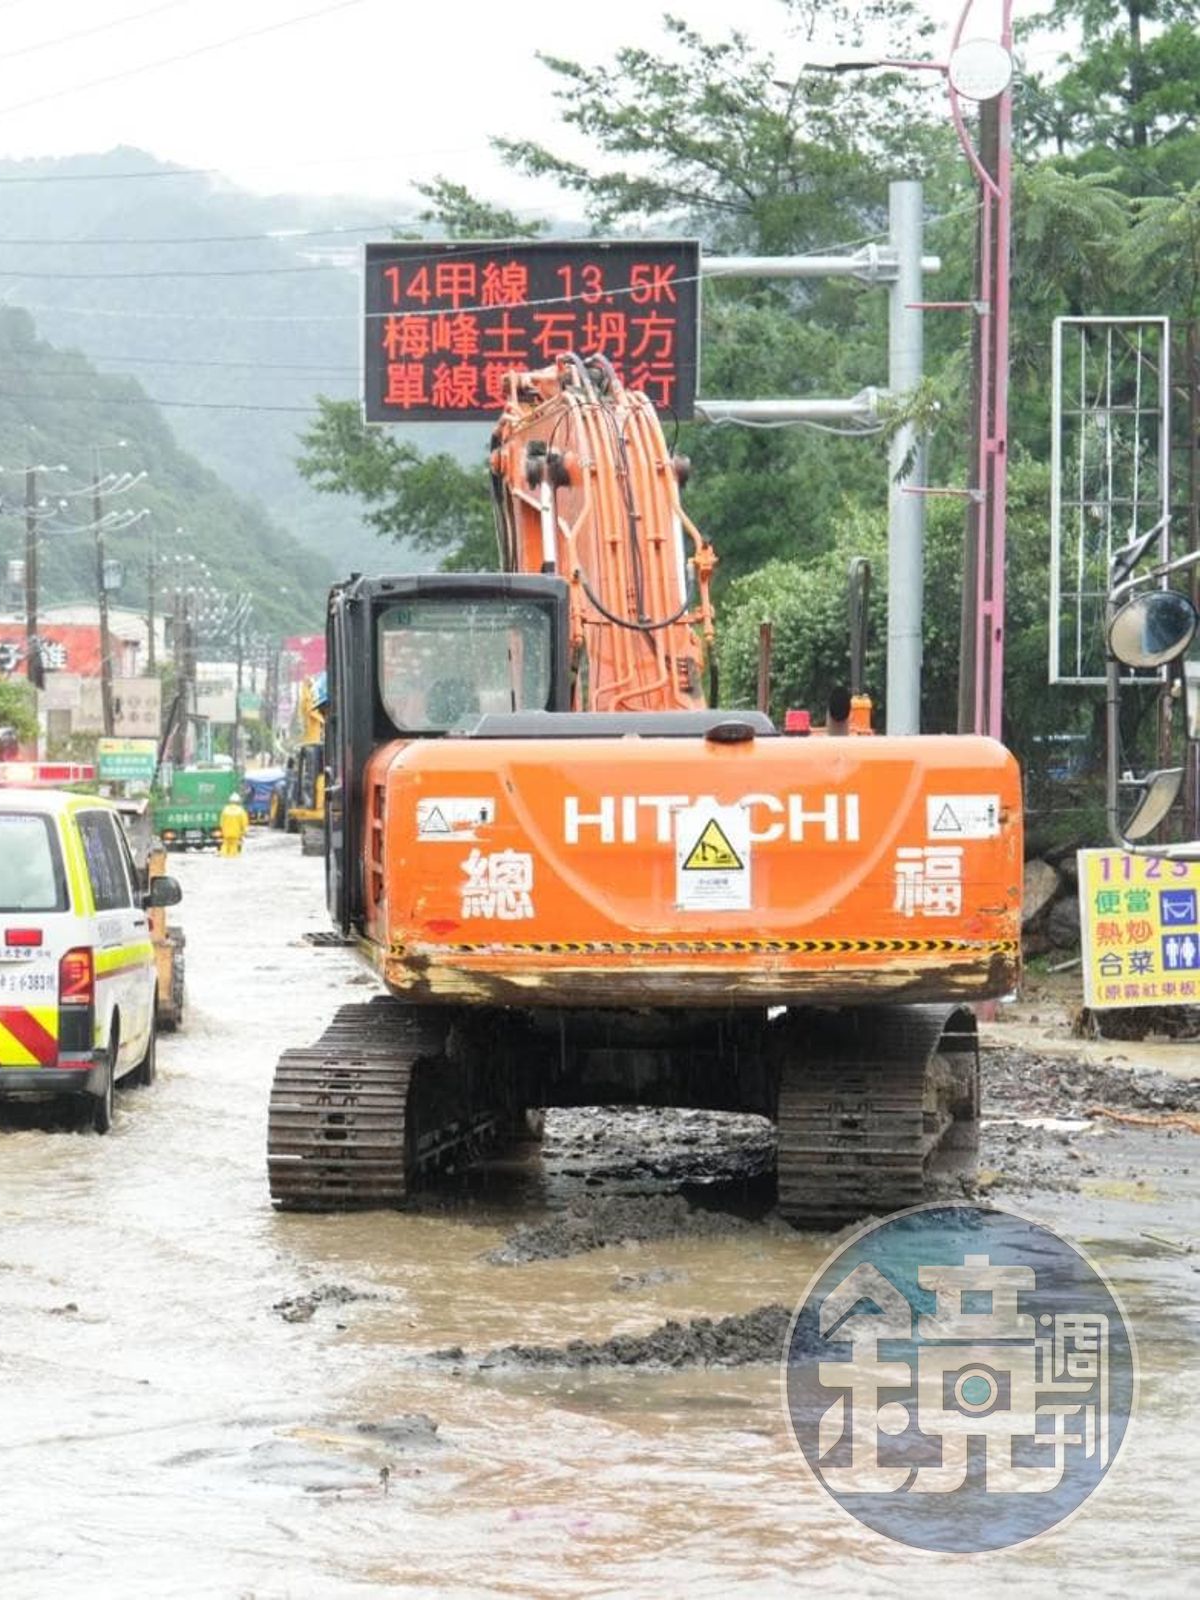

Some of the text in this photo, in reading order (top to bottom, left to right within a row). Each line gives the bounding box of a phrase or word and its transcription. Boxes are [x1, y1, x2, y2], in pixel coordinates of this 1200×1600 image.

[384, 261, 529, 308] 14甲線
[383, 311, 677, 360] 梅峰土石坍方
[384, 362, 677, 410] 單線雙行
[565, 793, 860, 844] HITCHI
[460, 846, 964, 920] 總 福
[1095, 888, 1151, 915] 便當
[1096, 919, 1154, 946] 熱炒
